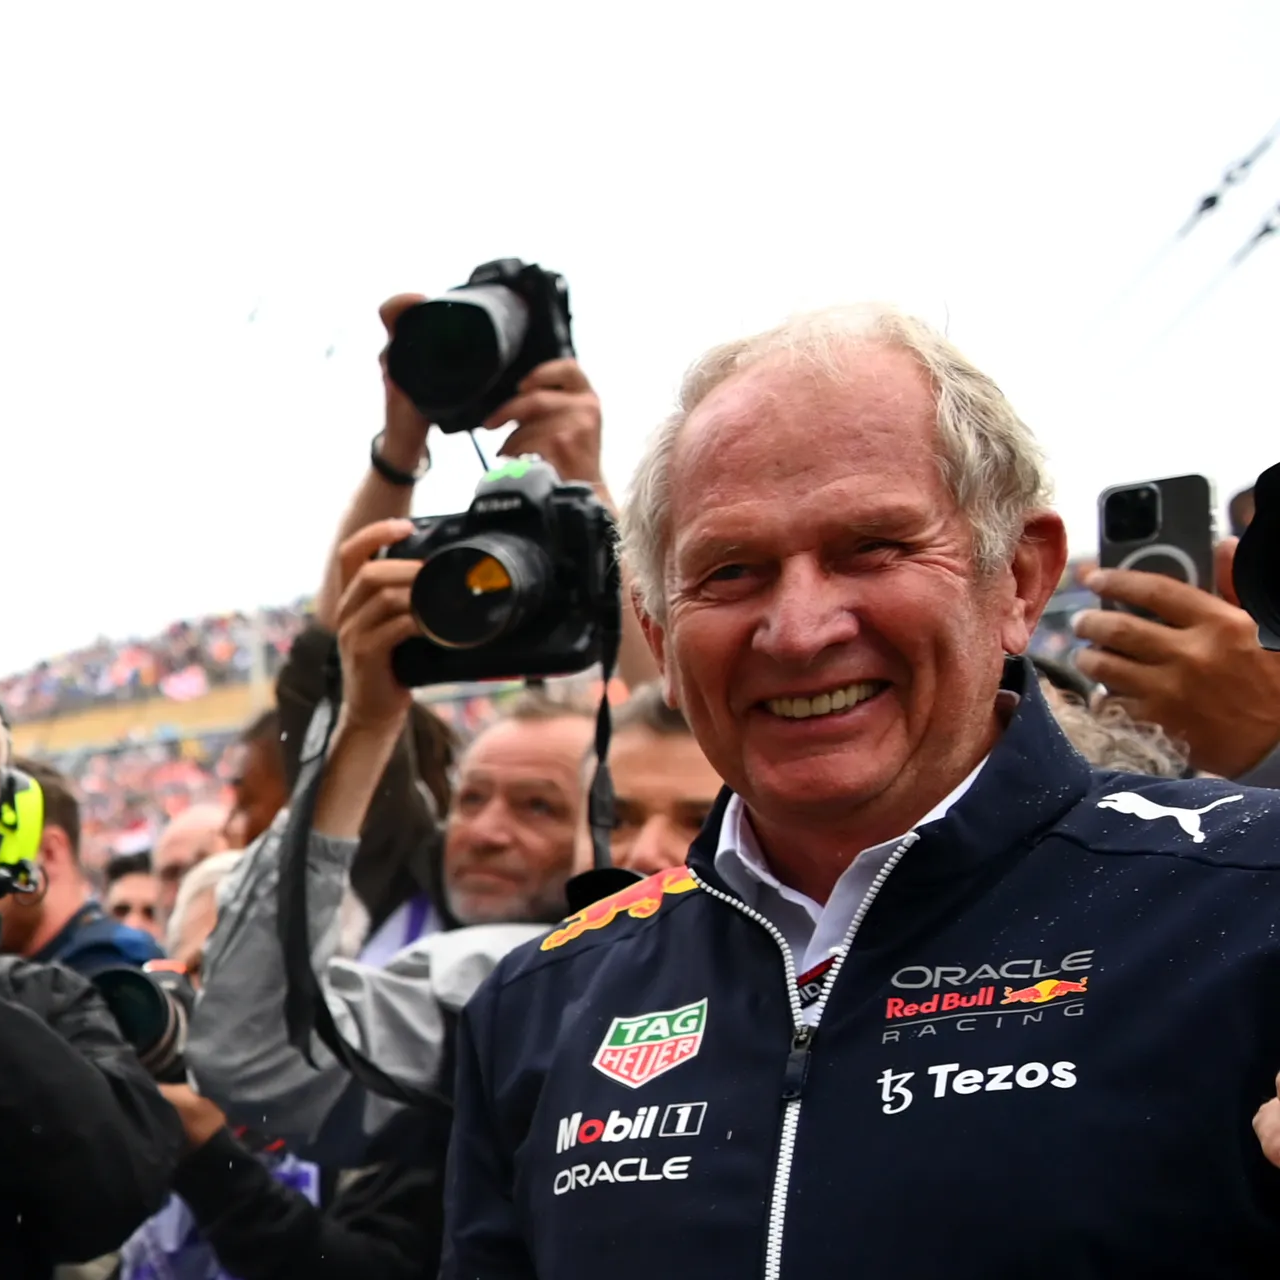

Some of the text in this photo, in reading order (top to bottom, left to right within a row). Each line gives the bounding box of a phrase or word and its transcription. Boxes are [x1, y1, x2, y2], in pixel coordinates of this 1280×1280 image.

[891, 950, 1095, 989] ORACLE
[621, 1009, 699, 1045] TAG
[882, 1004, 1085, 1044] RACING
[602, 1038, 694, 1081] HEUER
[927, 1061, 1077, 1098] Tezos
[556, 1106, 659, 1154] Mobil
[553, 1156, 692, 1195] ORACLE
